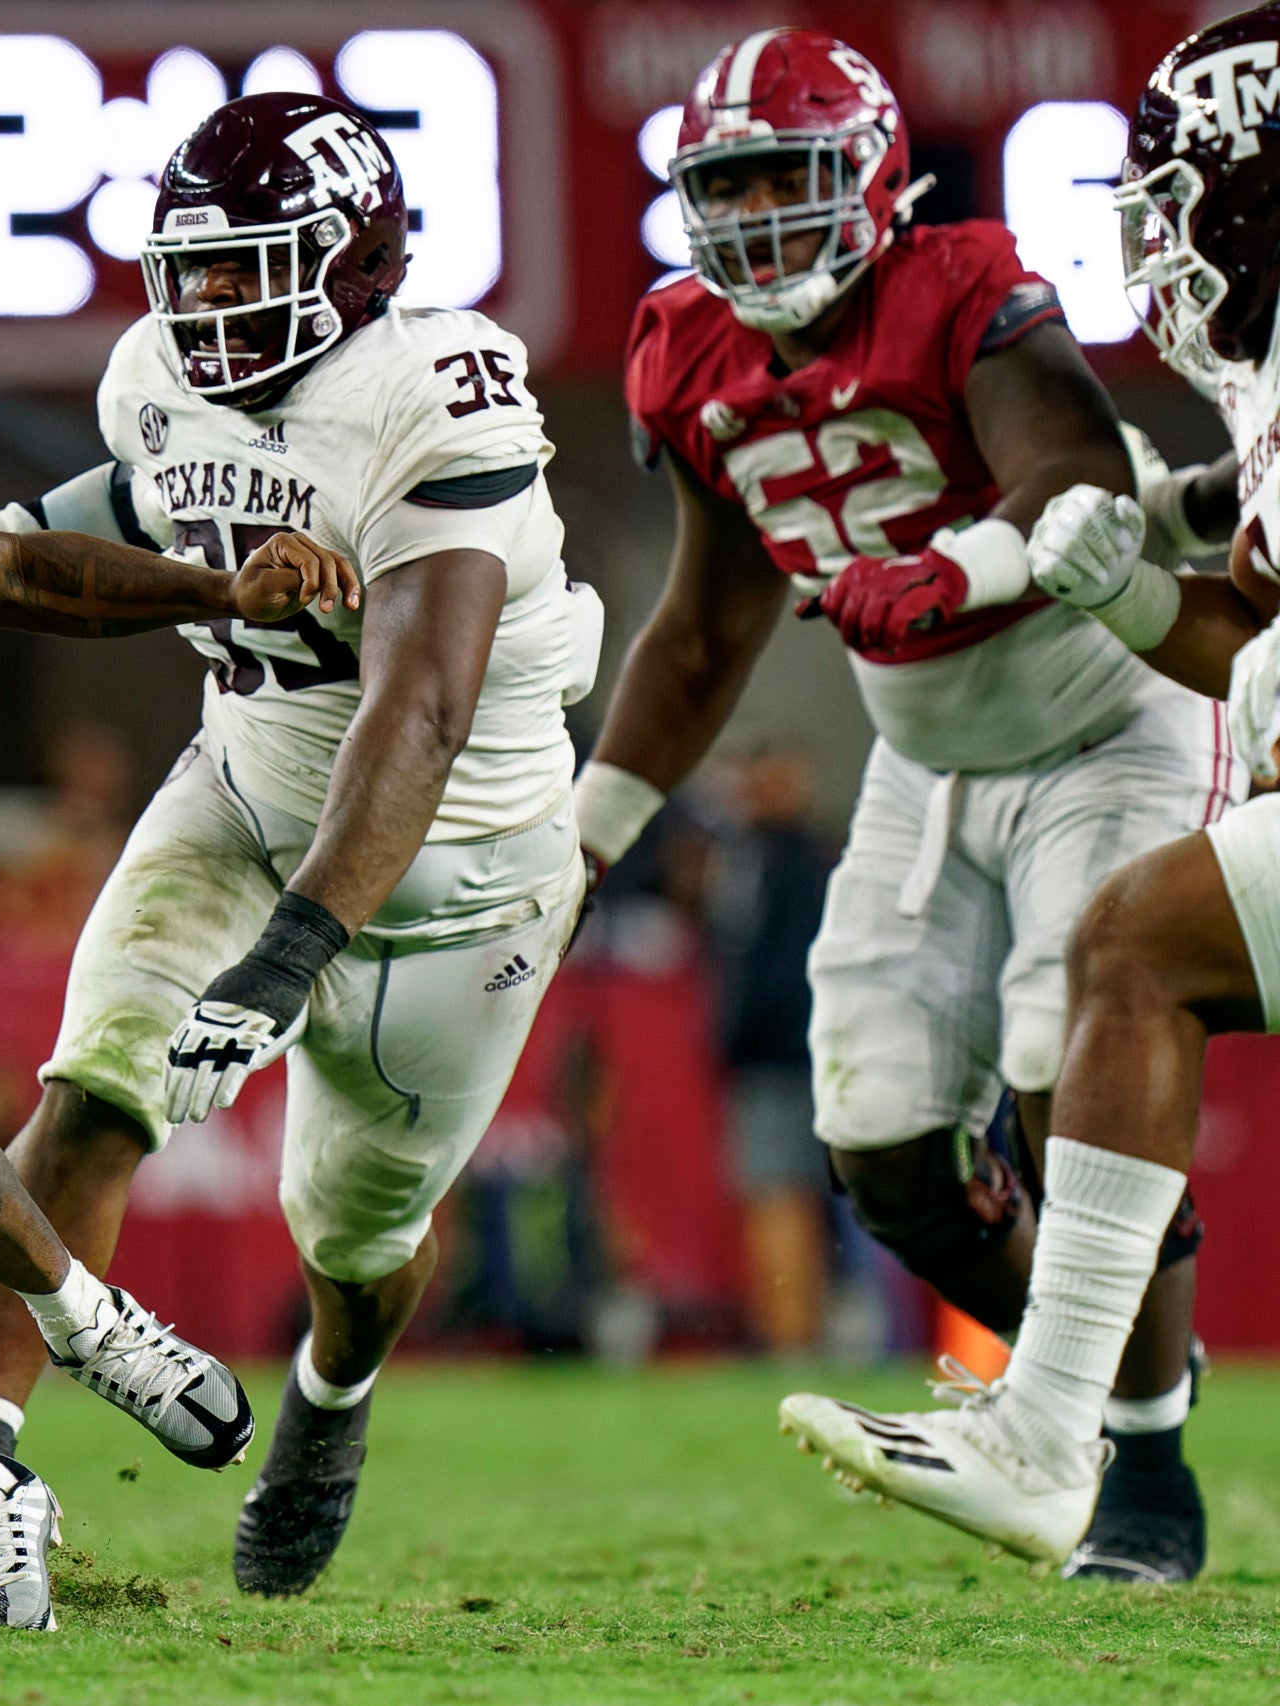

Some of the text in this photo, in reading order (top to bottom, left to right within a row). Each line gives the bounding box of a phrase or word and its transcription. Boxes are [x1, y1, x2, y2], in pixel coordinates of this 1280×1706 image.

[175, 212, 209, 227] AGGIES
[433, 349, 522, 419] 35
[153, 461, 317, 531] TEXAS A&M
[722, 407, 949, 597] 52
[484, 966, 537, 993] adidas
